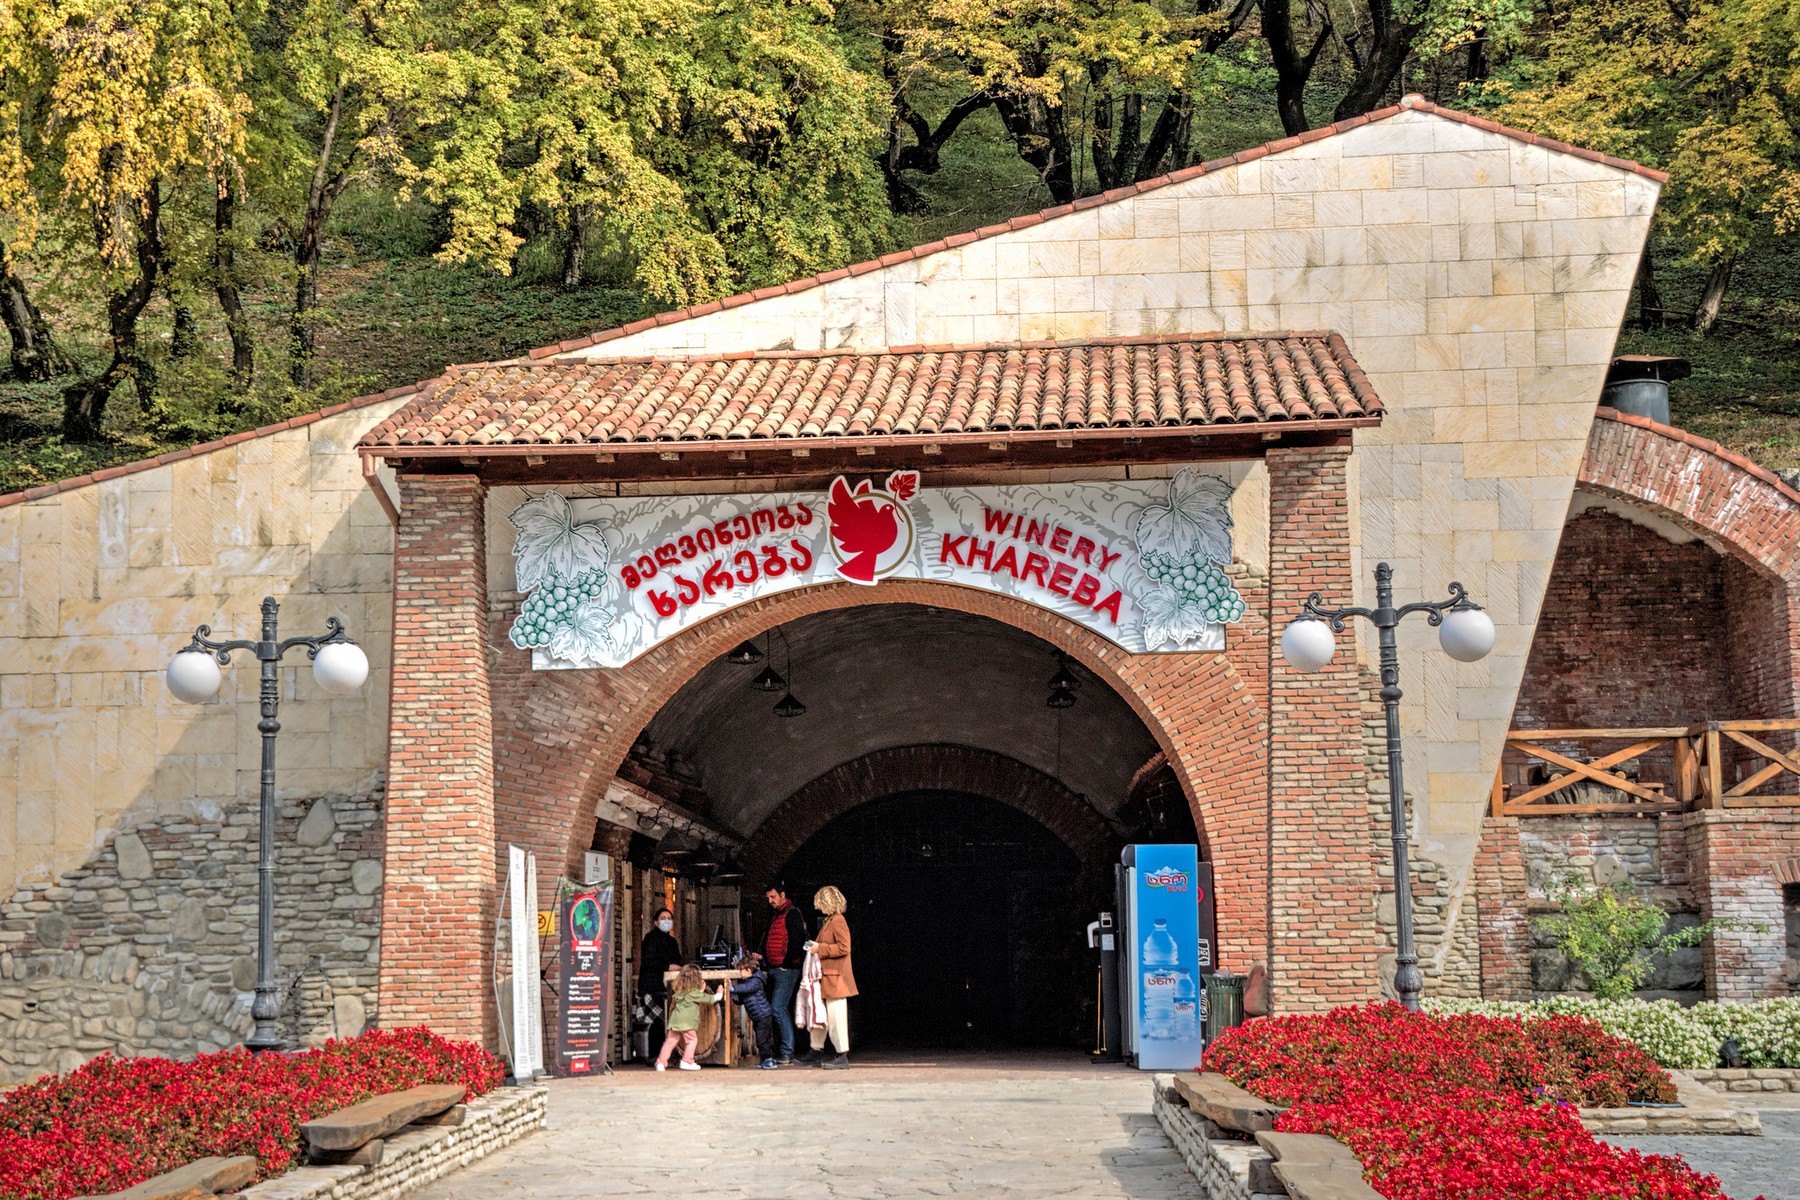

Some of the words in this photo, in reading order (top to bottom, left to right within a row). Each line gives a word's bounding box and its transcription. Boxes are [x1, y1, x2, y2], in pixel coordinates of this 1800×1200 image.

[620, 502, 813, 589] მეღვინეობა
[984, 507, 1121, 573] WINERY
[646, 539, 813, 617] ხარება
[939, 533, 1123, 624] KHAREBA
[1147, 874, 1187, 885] სნო
[1147, 977, 1176, 986] სნო
